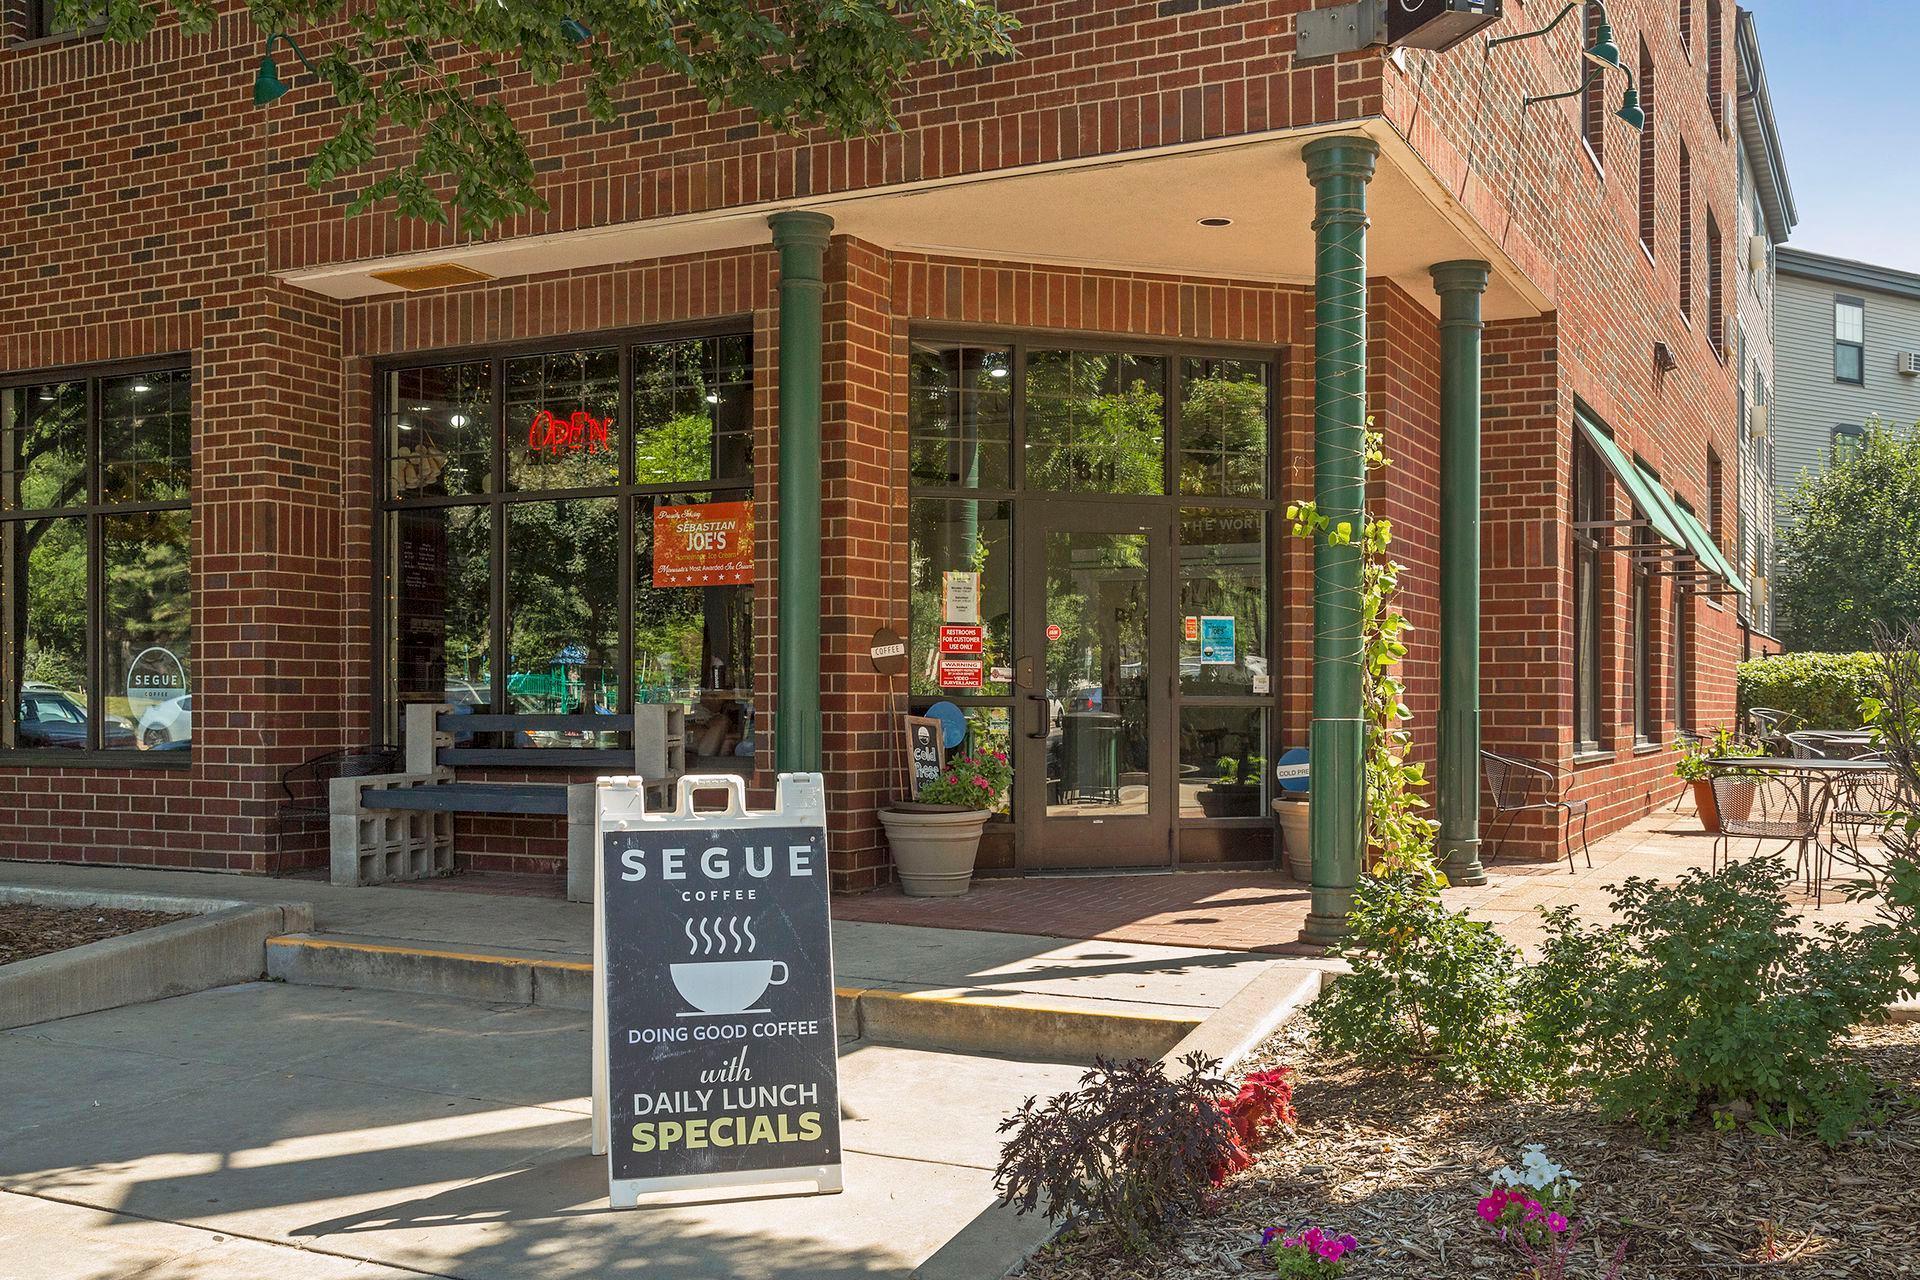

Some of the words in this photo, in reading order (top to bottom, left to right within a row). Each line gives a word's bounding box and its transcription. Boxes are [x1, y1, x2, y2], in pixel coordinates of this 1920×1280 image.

[529, 410, 613, 455] OPEN
[676, 521, 736, 533] SEBASTIAN
[686, 531, 727, 551] JOE'S
[875, 645, 901, 656] COFFEE
[135, 675, 178, 686] SEGUE
[914, 747, 937, 762] Cold
[1279, 769, 1297, 777] COLD
[620, 844, 815, 883] SEGUE
[681, 889, 757, 902] COFFEE
[627, 1025, 689, 1044] DOING
[692, 1023, 747, 1041] GOOD
[752, 1020, 819, 1038] COFFEE
[699, 1045, 753, 1084] with
[633, 1089, 714, 1116] DAILY
[722, 1083, 819, 1110] LUNCH
[631, 1111, 823, 1153] SPECIALS
